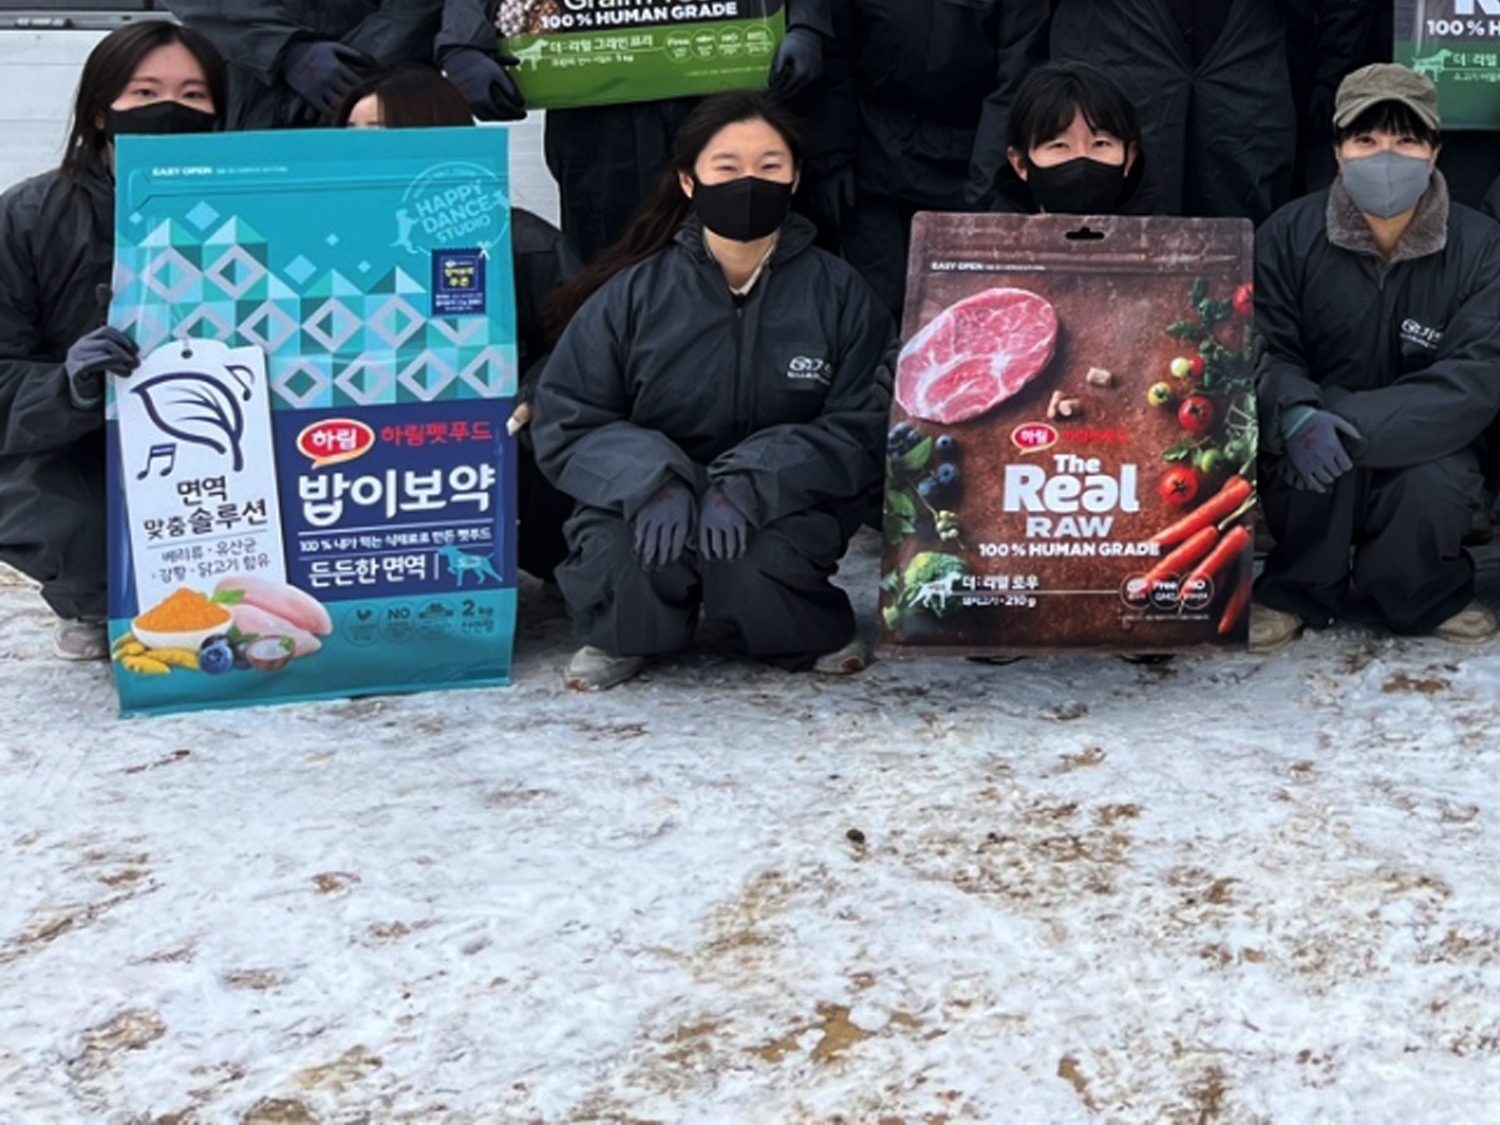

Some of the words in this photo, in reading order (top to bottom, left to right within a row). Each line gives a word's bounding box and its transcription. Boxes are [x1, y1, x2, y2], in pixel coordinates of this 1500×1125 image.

[597, 8, 667, 24] HUMAN
[672, 2, 738, 20] GRADE
[415, 179, 482, 217] HAPPY
[422, 194, 490, 234] DANCE
[436, 215, 491, 243] STUDIO
[931, 261, 956, 271] EASY
[958, 261, 983, 271] OPEN
[311, 426, 358, 451] 하림
[381, 421, 493, 446] 하림펫푸드
[1020, 429, 1049, 444] 하림
[1054, 454, 1101, 473] The
[177, 475, 227, 507] 면역
[298, 463, 496, 526] 밥이보약
[1003, 464, 1140, 513] Real
[1026, 516, 1113, 538] RAW
[1029, 543, 1097, 557] HUMAN
[1099, 543, 1161, 557] GRADE
[309, 557, 379, 587] 든든한
[382, 554, 426, 581] 면역
[388, 608, 411, 619] NO
[461, 599, 476, 617] 2
